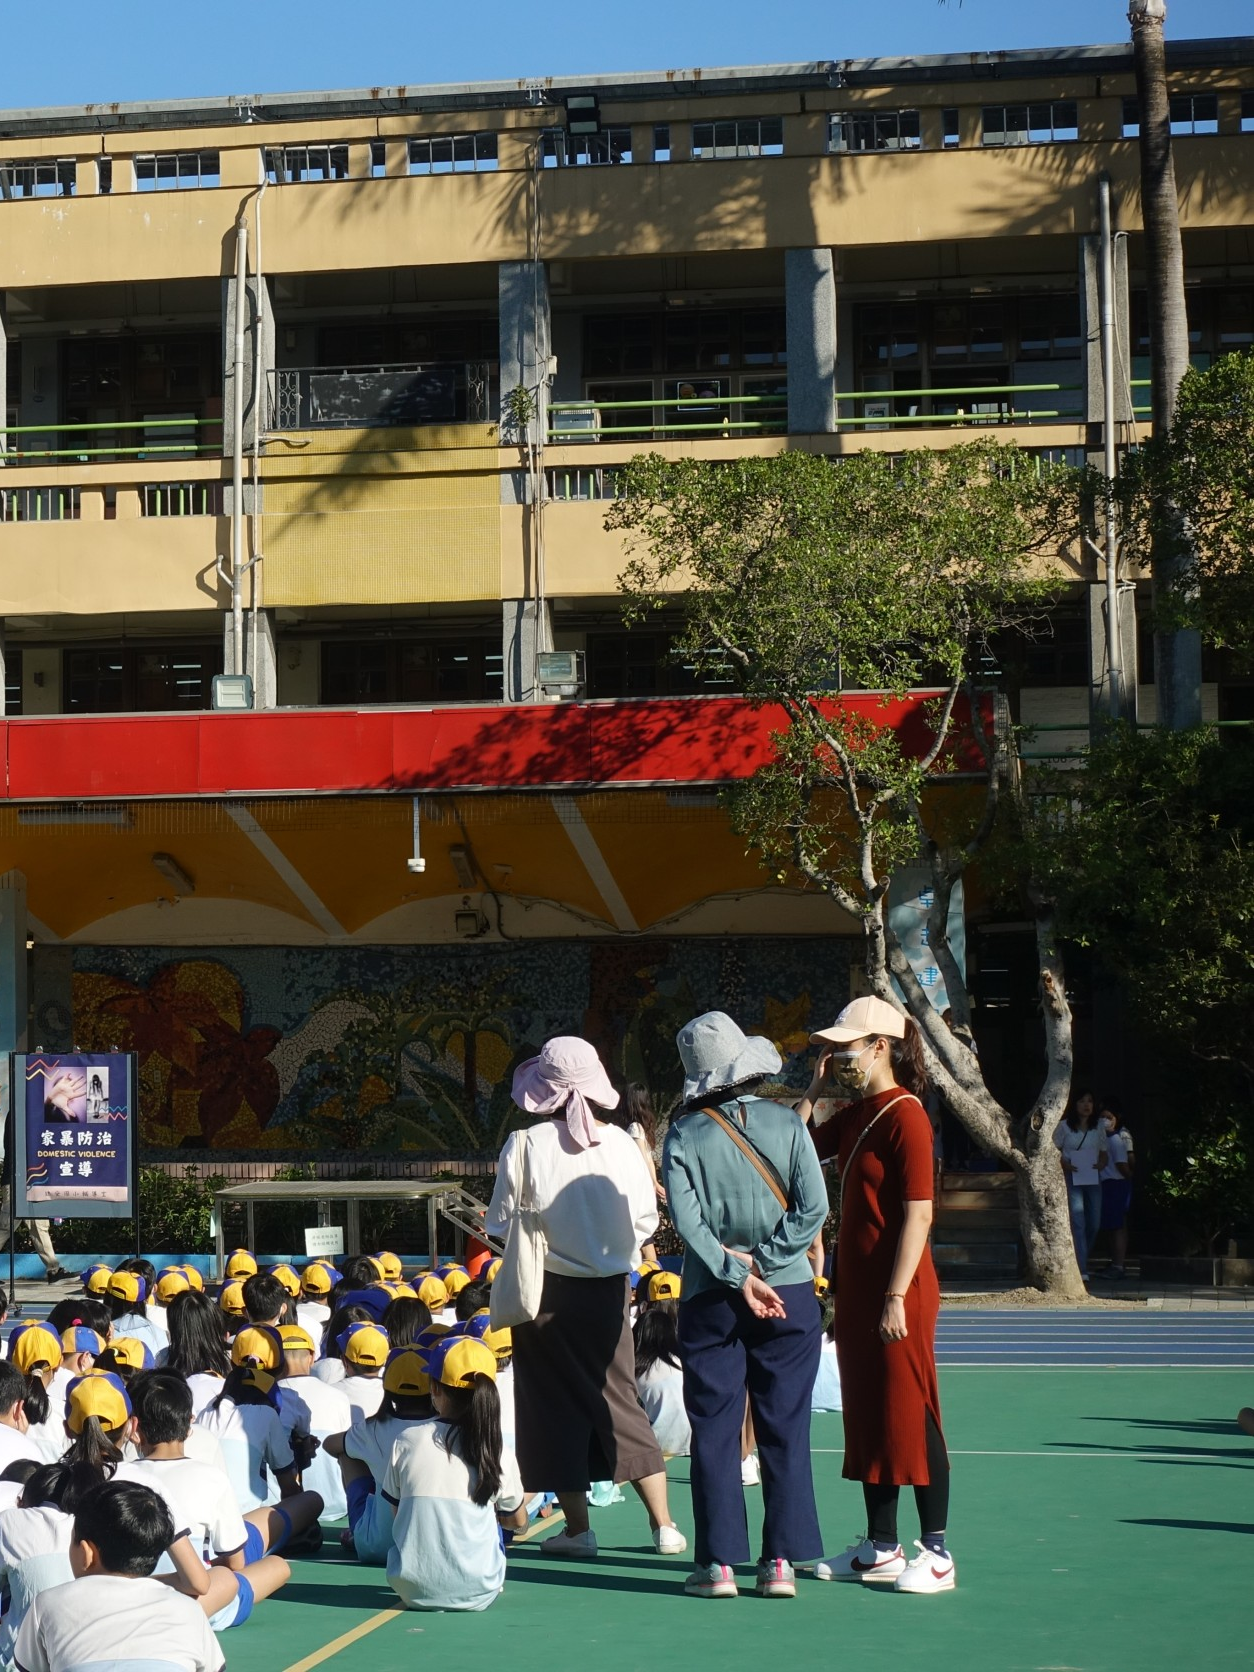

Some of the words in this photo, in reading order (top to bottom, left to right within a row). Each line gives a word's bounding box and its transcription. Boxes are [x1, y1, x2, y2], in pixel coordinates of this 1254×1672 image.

[41, 1130, 112, 1146] 家暴防治
[60, 1161, 93, 1177] 宣導
